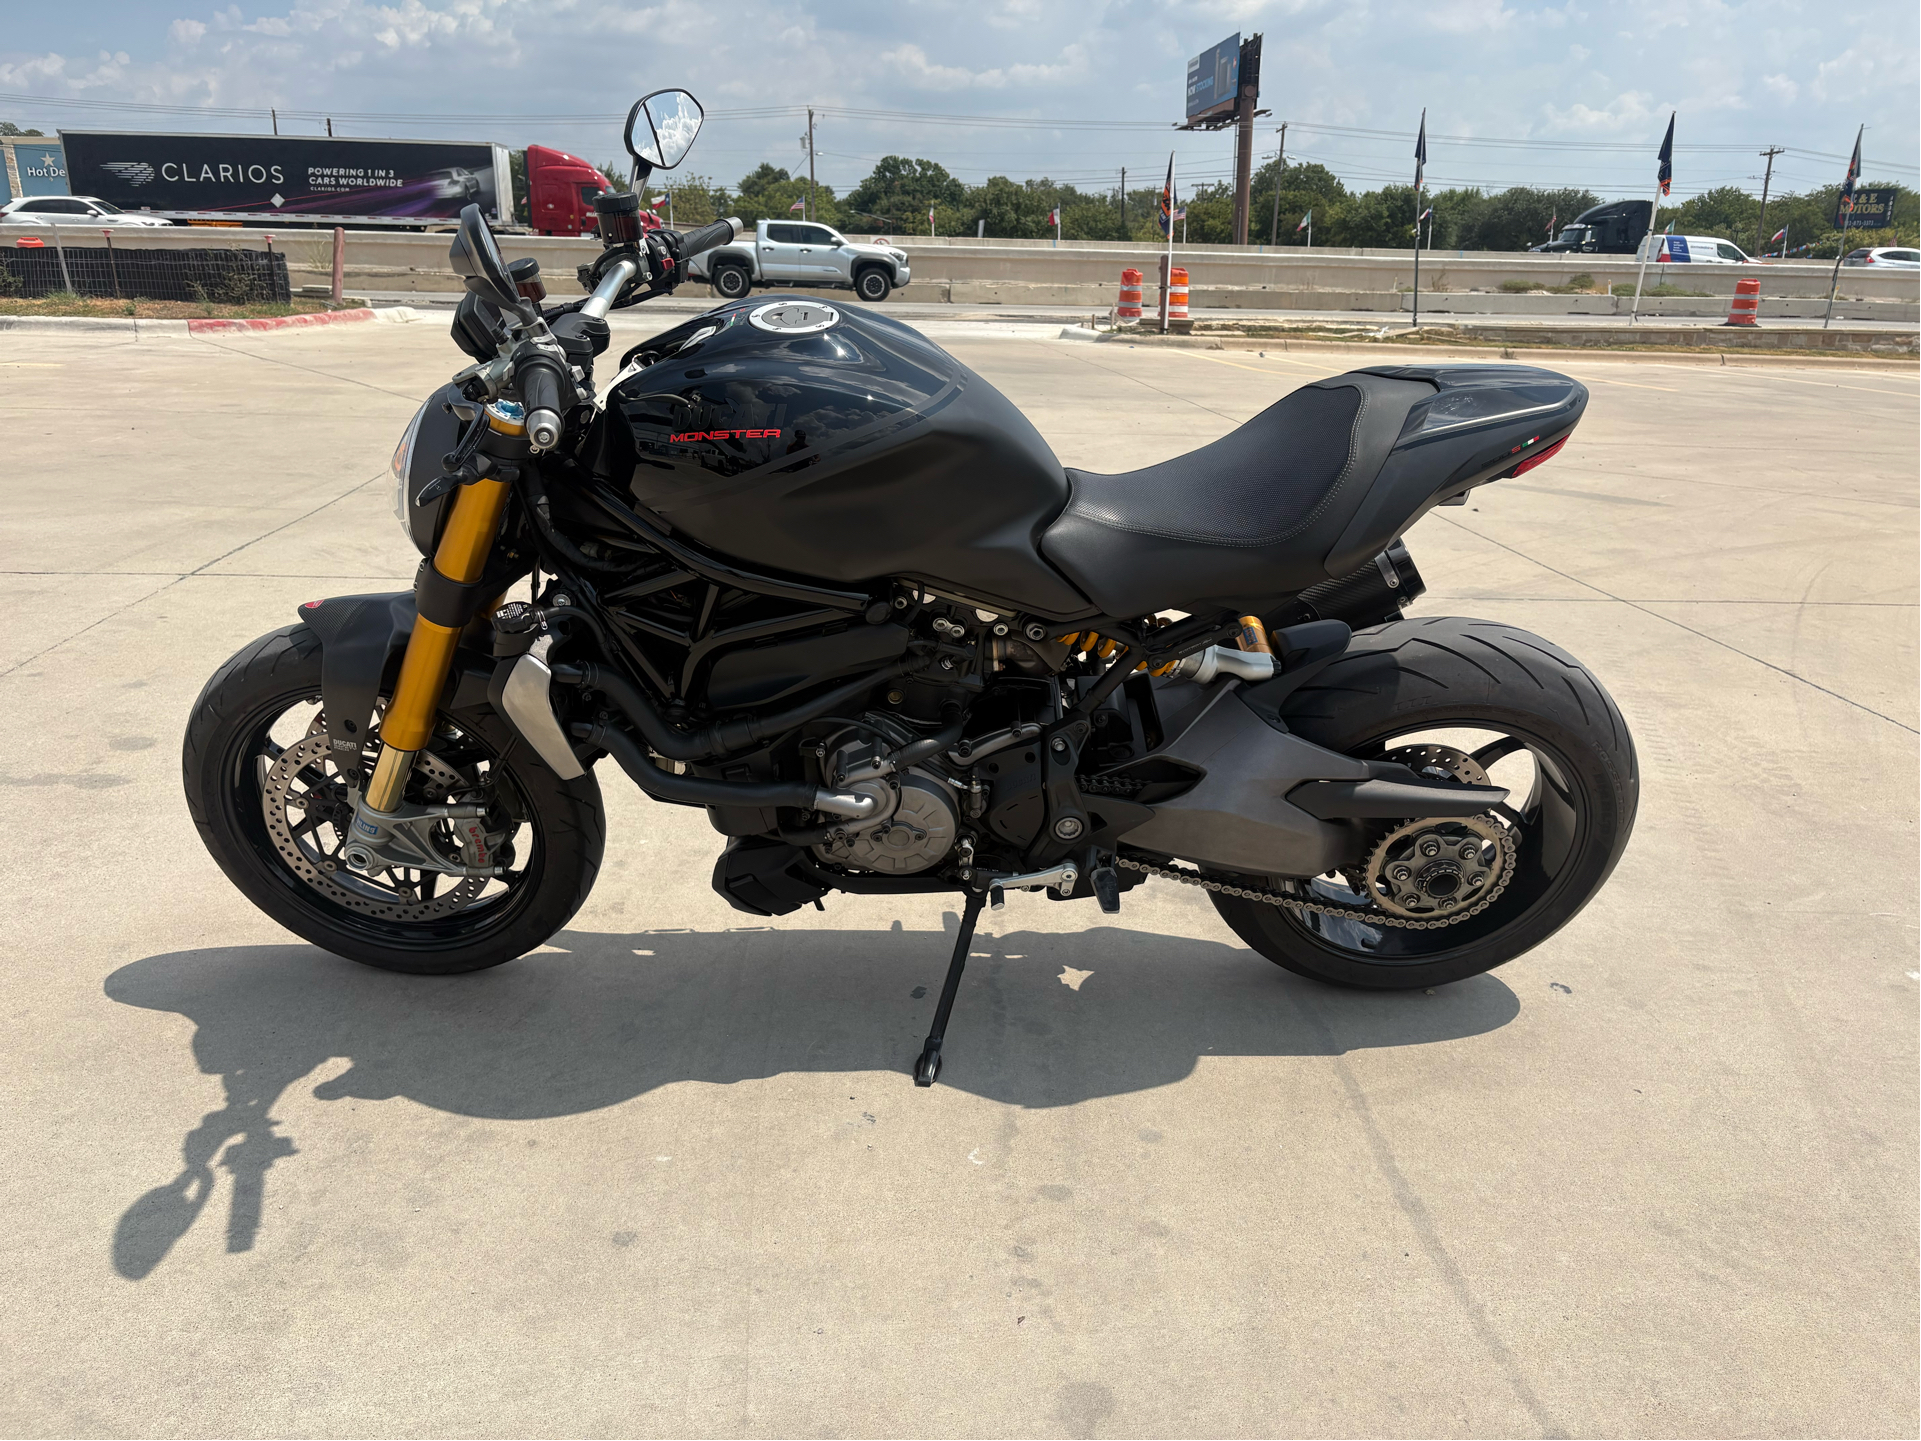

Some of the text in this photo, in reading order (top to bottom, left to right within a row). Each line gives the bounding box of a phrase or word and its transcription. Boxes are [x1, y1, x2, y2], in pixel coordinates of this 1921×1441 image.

[27, 166, 48, 177] Hot
[161, 162, 284, 184] CLARIOS
[308, 167, 395, 178] POWERING 1 IN 3
[309, 176, 403, 187] CARS WORLDWIDE
[1869, 193, 1878, 203] E
[1839, 203, 1885, 214] MOTORS
[672, 403, 787, 430] DUCATI
[669, 429, 781, 443] MONSTER
[333, 738, 357, 750] DUCATI
[468, 826, 488, 863] brembo
